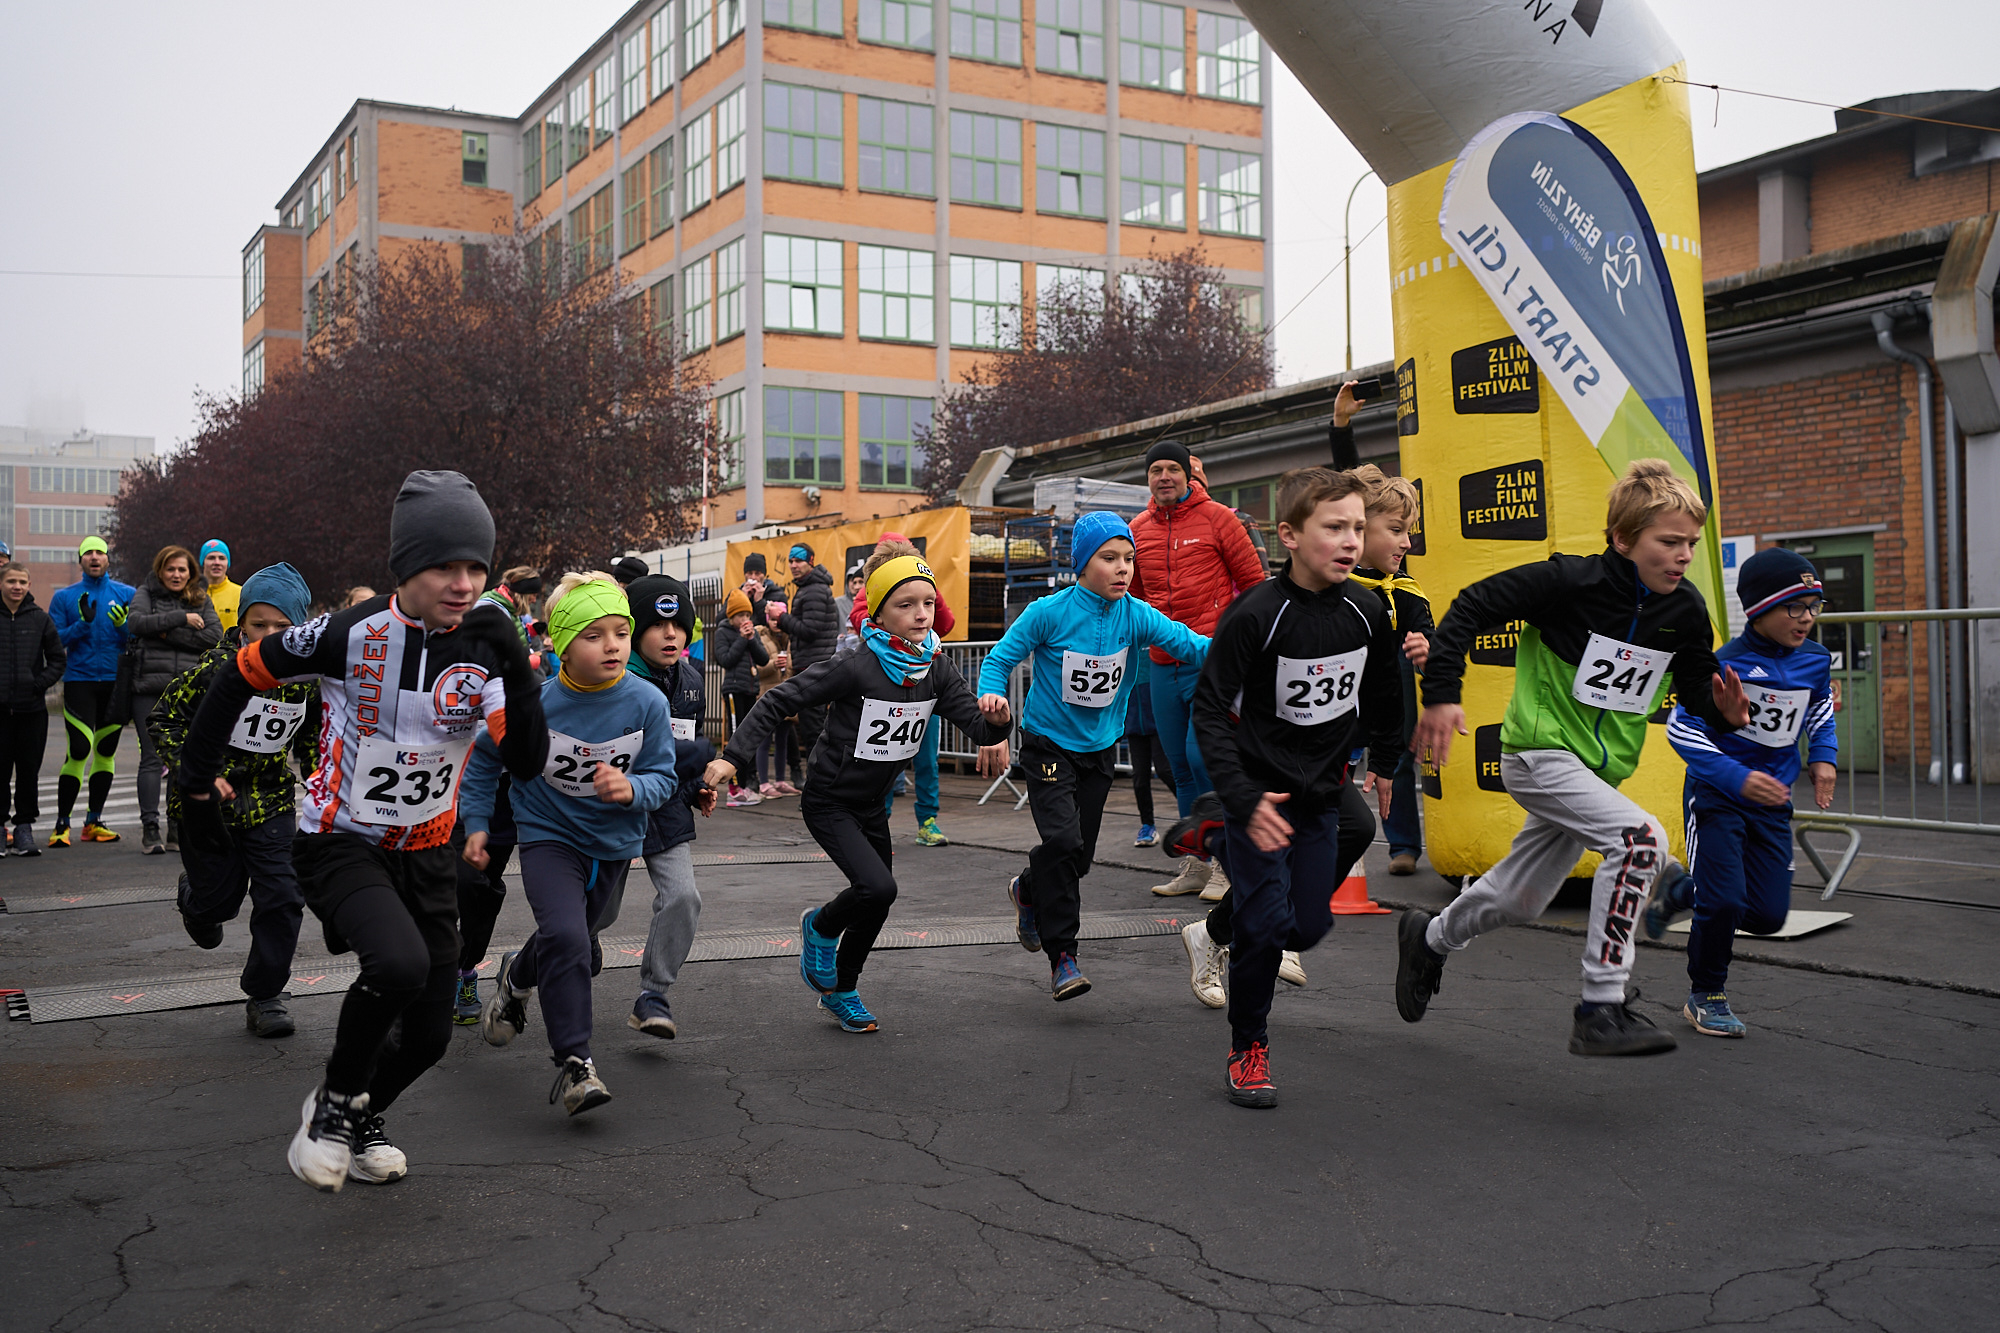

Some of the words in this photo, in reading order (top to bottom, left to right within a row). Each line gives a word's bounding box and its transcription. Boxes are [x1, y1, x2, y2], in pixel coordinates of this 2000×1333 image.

[1488, 342, 1529, 363] ZLÍN
[1488, 359, 1530, 379] FILM
[1459, 376, 1532, 400] FESTIVAL
[1495, 469, 1537, 489] ZLÍN
[1496, 487, 1538, 505] FILM
[1467, 503, 1540, 525] FESTIVAL
[1085, 658, 1099, 669] K5
[1615, 647, 1632, 661] K5
[1069, 665, 1122, 694] 529
[1307, 664, 1324, 676] K5
[1584, 658, 1654, 697] 241
[1285, 671, 1355, 708] 238
[1759, 692, 1777, 704] K5
[262, 703, 278, 714] K5
[888, 706, 903, 717] K5
[865, 718, 926, 746] 240
[395, 750, 419, 766] K5
[572, 744, 591, 758] K5
[363, 763, 453, 806] 233
[1601, 822, 1658, 966] FASTER
